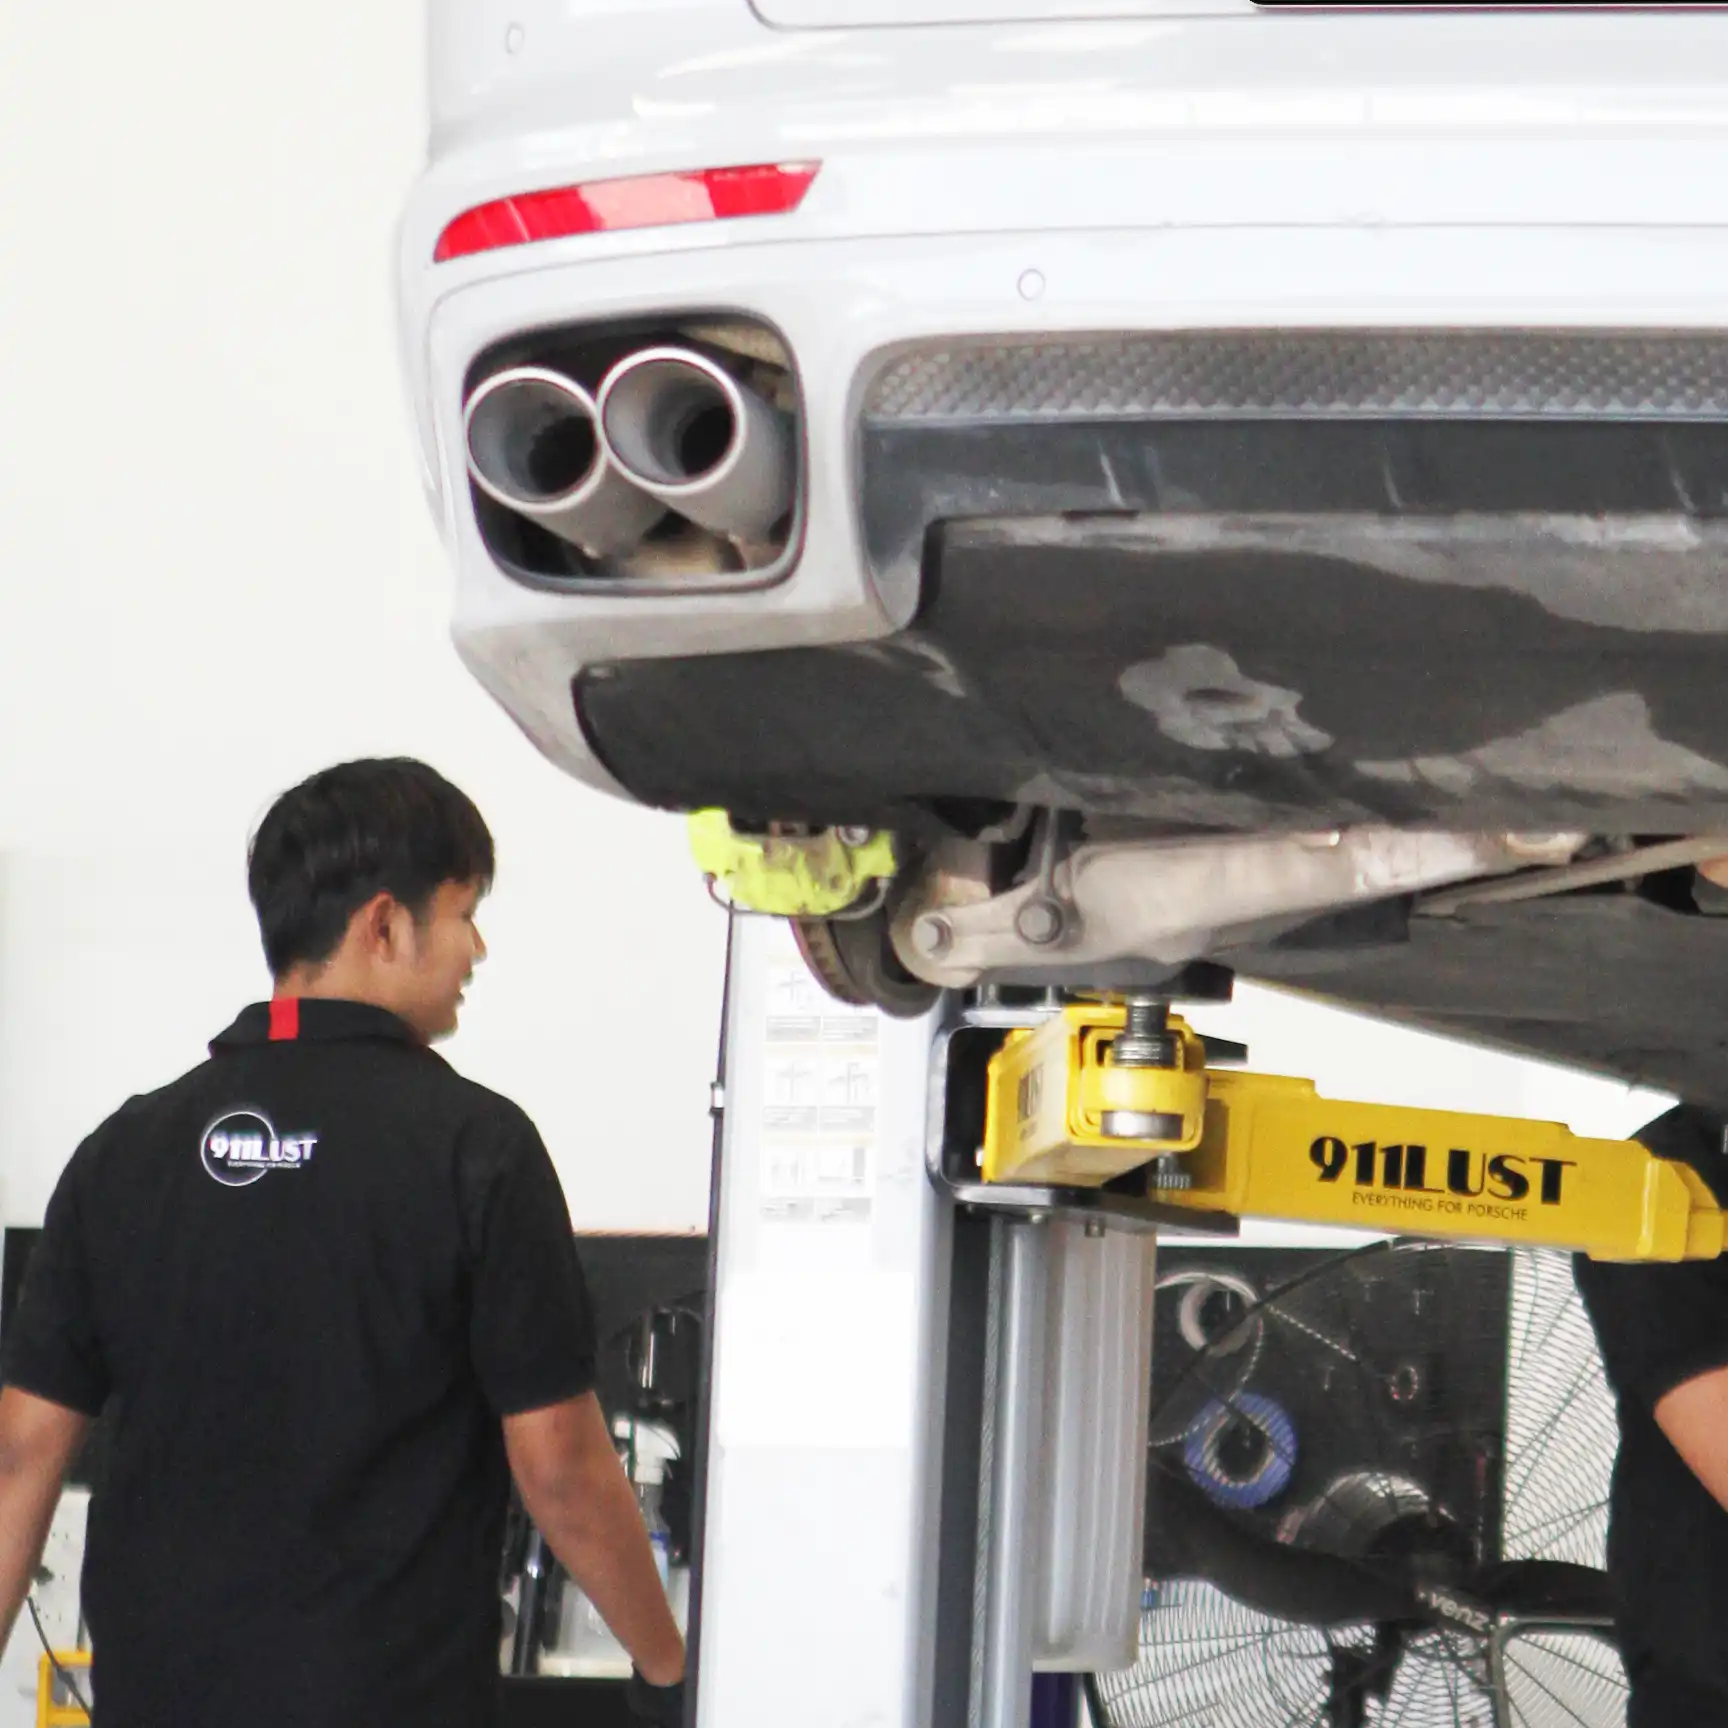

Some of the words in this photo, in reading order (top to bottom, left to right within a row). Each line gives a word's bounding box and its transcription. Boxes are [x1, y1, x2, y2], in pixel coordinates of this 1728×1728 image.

[209, 1134, 318, 1162] 911LUST
[1309, 1135, 1578, 1206] 911LUST
[1351, 1191, 1433, 1213] EVERYTHING
[1437, 1200, 1463, 1215] FOR
[1467, 1204, 1529, 1222] PORSCHE
